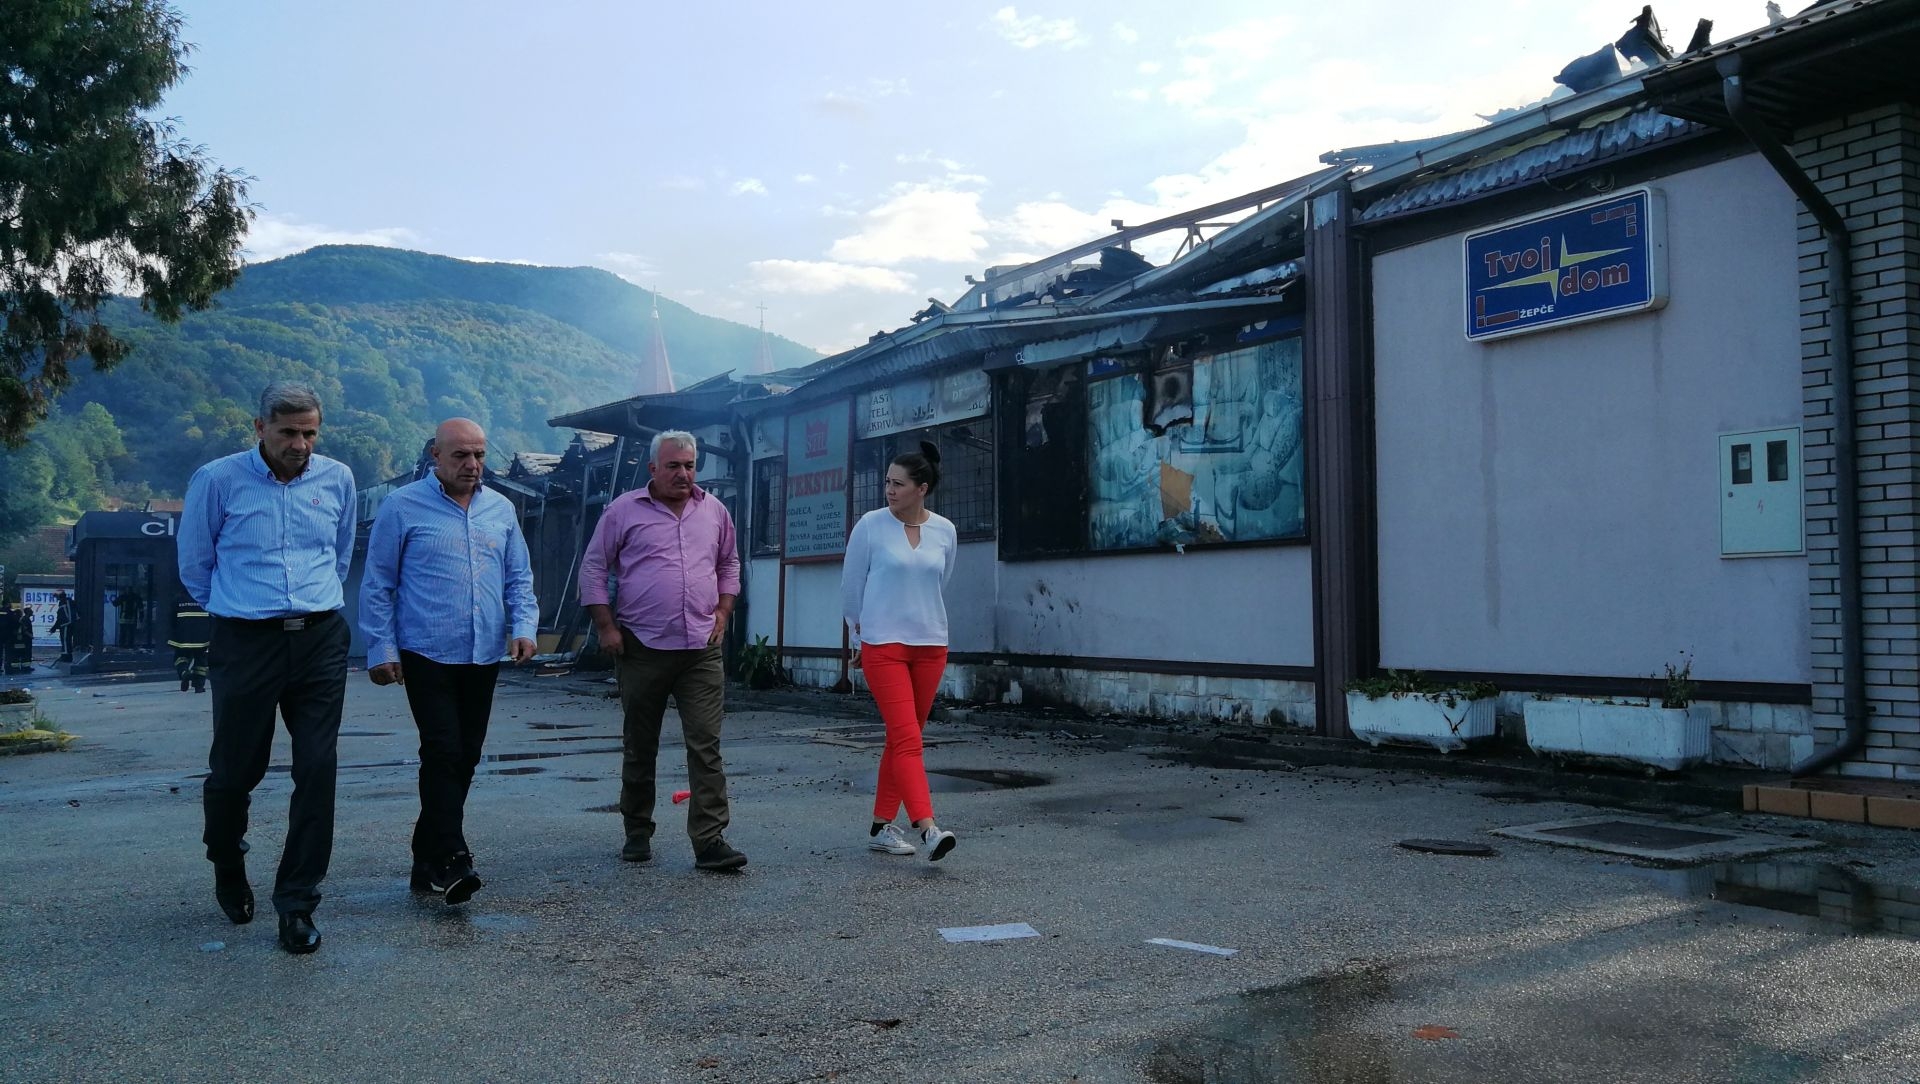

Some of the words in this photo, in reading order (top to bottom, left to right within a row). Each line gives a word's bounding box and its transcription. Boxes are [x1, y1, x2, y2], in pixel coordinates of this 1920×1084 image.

[1484, 236, 1552, 278] Tvoj
[1560, 262, 1630, 297] dom
[1519, 304, 1555, 320] ŽEPČE
[788, 466, 846, 499] TEKSTIL
